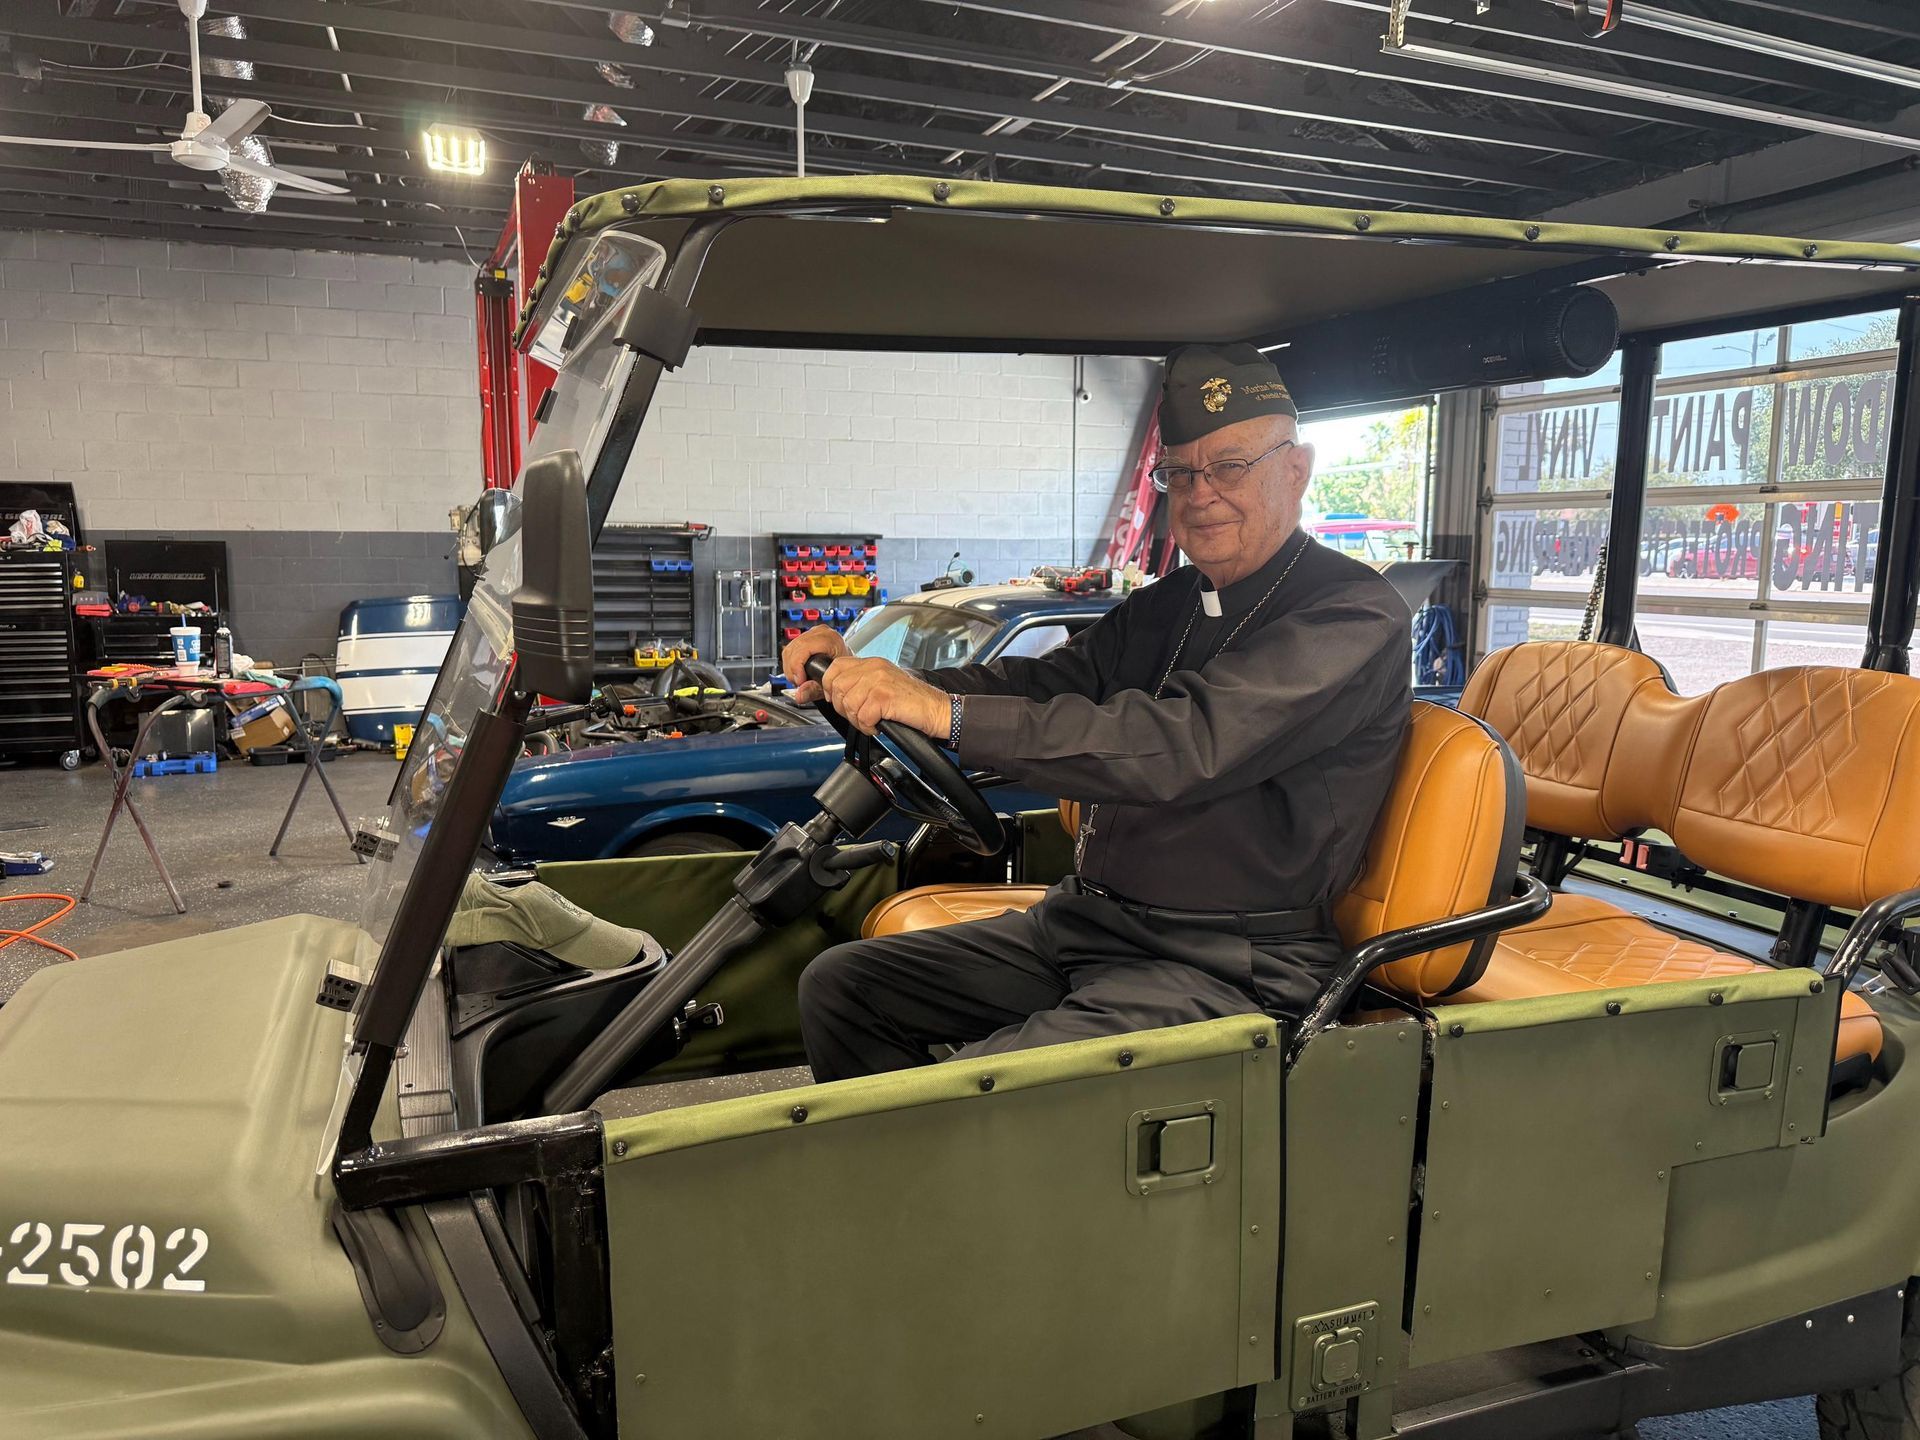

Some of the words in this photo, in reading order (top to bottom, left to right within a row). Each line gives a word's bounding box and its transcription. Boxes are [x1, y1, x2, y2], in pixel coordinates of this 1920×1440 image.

[0, 1221, 209, 1292] 2502
[1330, 1311, 1367, 1328] SUMMIT
[1306, 1391, 1337, 1405] BATTERY
[1339, 1382, 1363, 1395] GROUP
